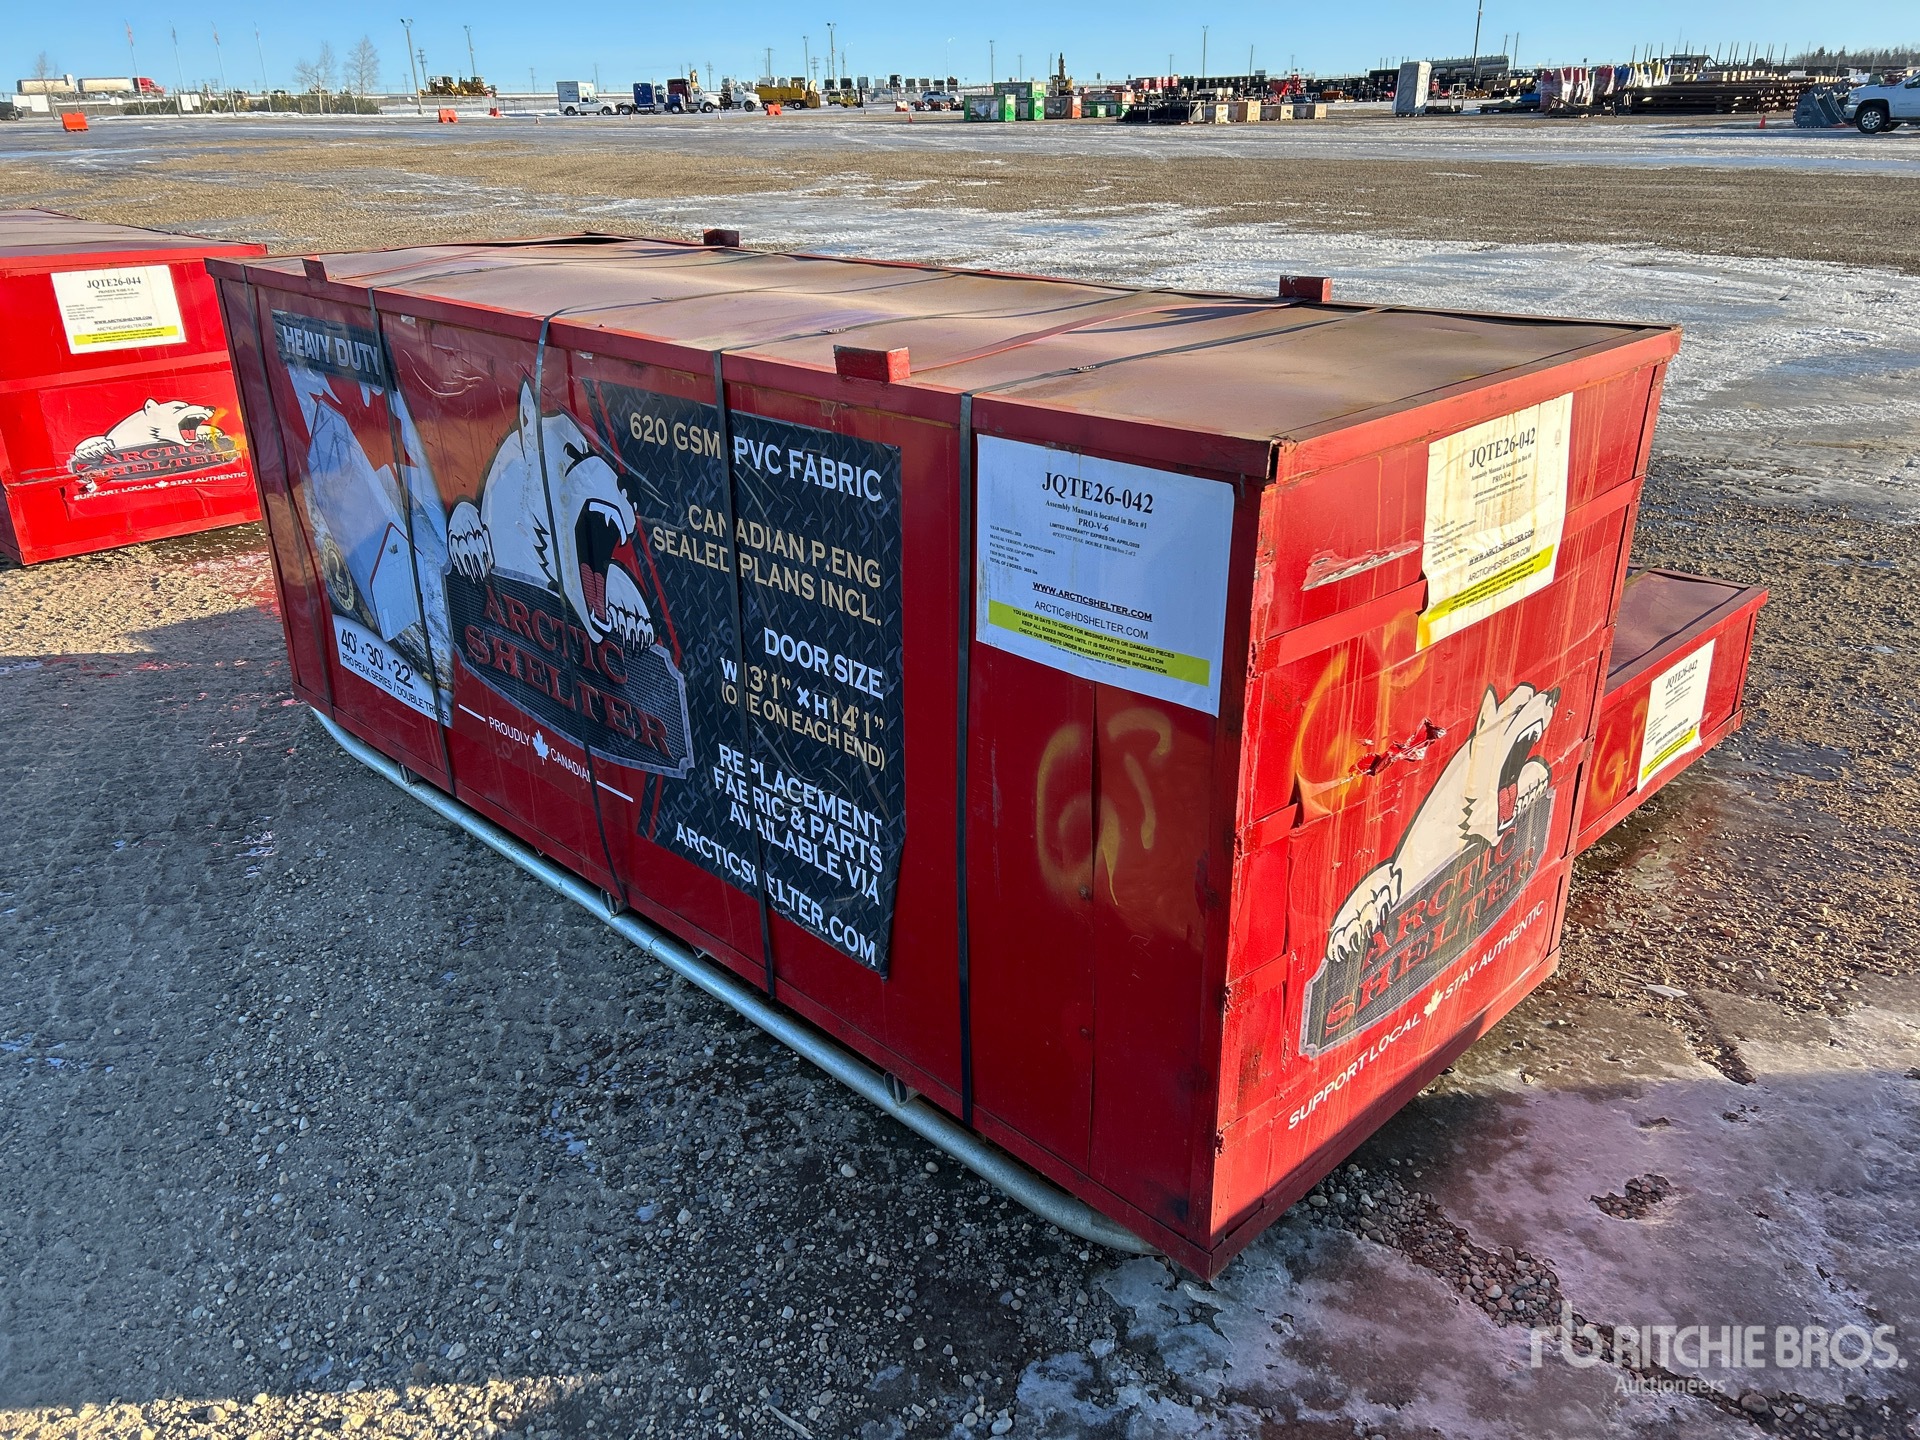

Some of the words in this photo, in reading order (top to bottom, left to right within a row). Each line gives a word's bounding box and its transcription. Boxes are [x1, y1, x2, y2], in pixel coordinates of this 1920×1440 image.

[87, 276, 141, 289] JQTE26-044
[282, 325, 331, 364] HEAVY
[334, 337, 380, 376] DUTY
[102, 442, 206, 464] ARCTIC
[630, 412, 668, 446] 620
[673, 422, 722, 460] GSM
[733, 435, 782, 475] PVC
[788, 448, 882, 502] FABRIC
[1469, 427, 1536, 468] JQTE26-042
[73, 488, 120, 501] SUPPORT
[121, 484, 154, 493] LOCAL
[170, 479, 194, 487] STAY
[195, 472, 248, 483] AUTHENTIC
[1042, 472, 1154, 514] JQTE26-042
[1045, 500, 1071, 512] Assembly
[1072, 505, 1093, 517] Manual
[1093, 510, 1098, 518] is
[1100, 512, 1120, 523] located
[1128, 519, 1138, 528] Box
[688, 504, 804, 563] CANADIAN
[811, 540, 881, 588] P.ENG
[1049, 522, 1065, 531] LIMITED
[1078, 518, 1109, 532] PRO-V-6
[653, 526, 730, 572] SEALED
[739, 552, 815, 600] PLANS
[821, 578, 882, 627] INCL.
[1032, 582, 1152, 621] WWW.ARCTICSHELTER.COM
[483, 584, 628, 685] ARCTIC
[1013, 608, 1021, 616] YOU
[1022, 612, 1033, 620] HAVE
[1040, 617, 1051, 625] DAYS
[1058, 623, 1074, 631] CHECK
[1074, 627, 1084, 635] FOR
[1084, 631, 1103, 641] MISSING
[1104, 636, 1120, 645] PARTS
[1129, 643, 1155, 654] DAMAGED
[1155, 649, 1175, 659] PIECES
[1021, 620, 1033, 628] KEEP
[1041, 627, 1057, 635] BOXES
[1057, 631, 1074, 641] INDOOR
[1074, 636, 1087, 645] UNTIL
[1099, 644, 1115, 652] READY
[1116, 648, 1126, 656] FOR
[1127, 652, 1164, 665] INSTALLATION
[1034, 601, 1149, 640] ARCTIC@HDSHELTER.COM
[341, 628, 357, 655] 40'
[365, 642, 384, 671] 30'
[392, 659, 414, 690] 22'
[763, 626, 829, 677] DOOR
[833, 653, 884, 700] SIZE
[1018, 627, 1033, 636] CHECK
[1033, 631, 1042, 639] OUR
[1043, 635, 1062, 646] WEBSITE
[1062, 641, 1077, 651] UNDER
[1077, 645, 1105, 658] WARRANTY
[1117, 657, 1131, 666] MORE
[1132, 661, 1167, 675] INFORMATION
[342, 652, 355, 667] PRO
[354, 659, 371, 678] PEAK
[371, 669, 393, 689] SERIES
[397, 685, 424, 709] DOUBLE
[424, 701, 449, 721] TRSS
[464, 624, 675, 760] SHELTER
[488, 716, 530, 746] PROUDLY
[763, 700, 788, 728] ON
[792, 710, 840, 749] EACH
[843, 731, 885, 772] END)
[713, 766, 786, 822] FABRIC
[790, 806, 806, 834] &
[810, 813, 883, 873] PARTS
[718, 743, 882, 843] REPLACEMENT
[729, 801, 842, 881] AVAILABLE
[845, 858, 880, 906] VIA
[1361, 828, 1517, 972] ARCTIC
[1325, 846, 1535, 1038] SHELTER
[1288, 1051, 1375, 1130] SUPPORT
[1369, 1012, 1421, 1062] LOCAL
[1444, 966, 1478, 1000] STAY
[1478, 900, 1545, 972] AUTHENTIC
